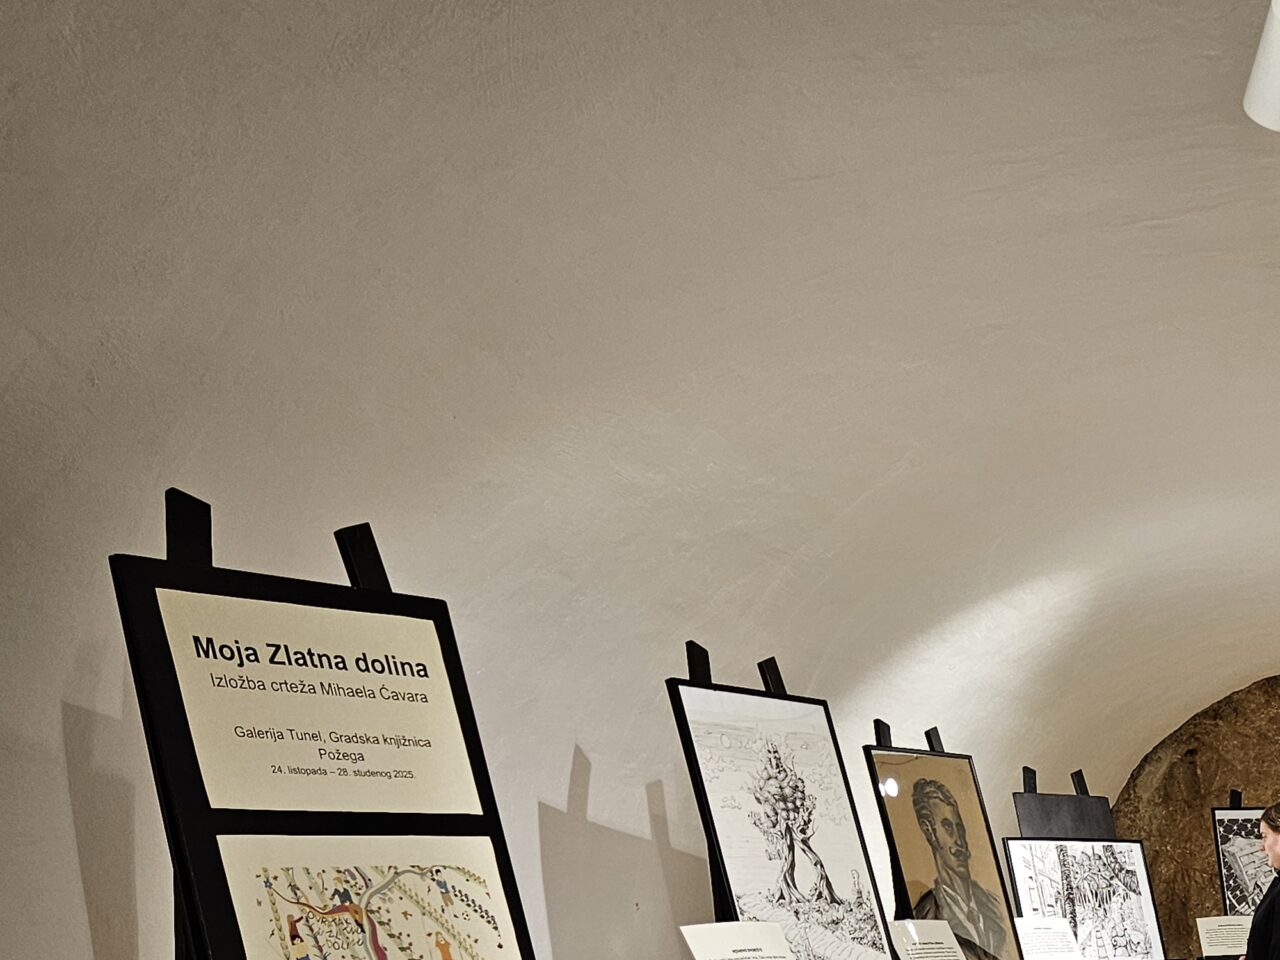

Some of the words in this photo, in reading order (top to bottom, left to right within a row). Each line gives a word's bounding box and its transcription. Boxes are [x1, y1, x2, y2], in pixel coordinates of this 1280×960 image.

[192, 634, 261, 668] Moja
[265, 643, 349, 671] Zlatna
[354, 652, 430, 678] dolina
[210, 672, 267, 691] Izložba
[270, 679, 317, 695] crteža
[319, 681, 377, 699] Mihaela
[234, 725, 285, 743] Galerija
[286, 728, 327, 744] Tunel,
[328, 731, 380, 745] Gradska
[381, 733, 432, 749] knjižnica
[318, 748, 365, 764] Požega
[270, 764, 287, 775] 24.
[287, 765, 328, 776] listopada
[352, 769, 393, 780] studenog
